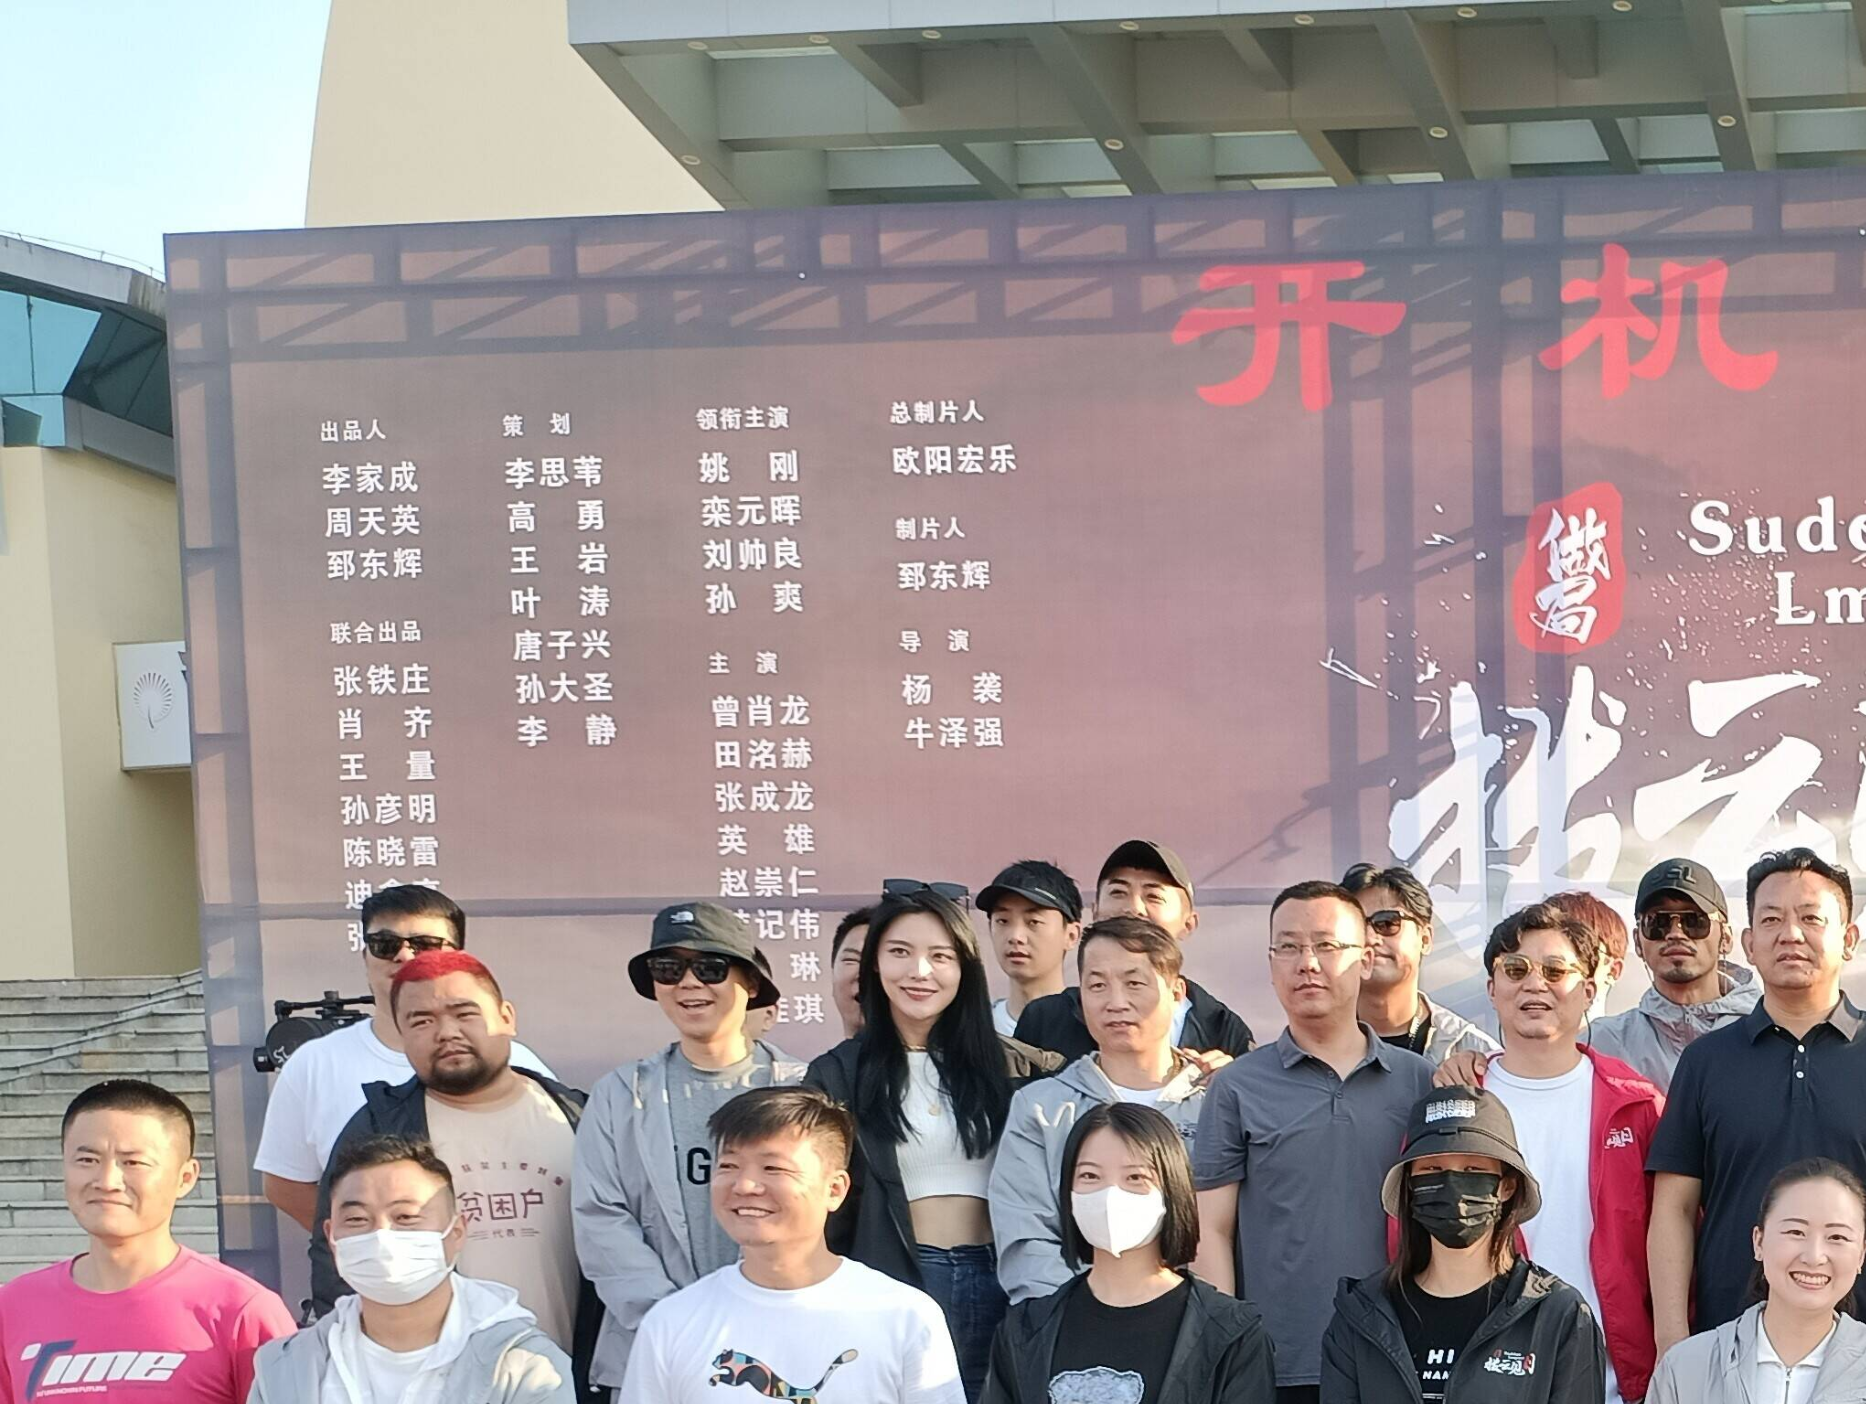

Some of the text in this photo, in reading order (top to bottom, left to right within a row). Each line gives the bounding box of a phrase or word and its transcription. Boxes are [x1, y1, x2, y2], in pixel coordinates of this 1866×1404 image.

[696, 405, 790, 431] 领衔主演
[889, 400, 984, 424] 总制片人
[320, 419, 386, 442] 出品人
[505, 456, 603, 489] 李思苇
[892, 444, 1017, 475] 欧阳宏乐
[322, 461, 418, 495] 李家成
[325, 504, 420, 537] 周天英
[701, 495, 802, 528] 栾元晖
[895, 516, 966, 540] 制片人
[327, 548, 422, 580] 郅东辉
[702, 537, 802, 570] 刘帅良
[897, 560, 991, 591] 郅东辉
[330, 620, 422, 644] 联合出品
[513, 630, 611, 662] 唐子兴
[333, 663, 430, 696] 张铁庄
[516, 673, 613, 704] 孙大圣
[711, 694, 811, 728] 曾肖龙
[904, 716, 1004, 749] 牛泽强
[341, 793, 437, 825] 孙彦明
[715, 781, 814, 813] 张成龙
[343, 836, 439, 868] 陈晓雷
[719, 866, 819, 898] 赵崇仁
[731, 908, 820, 940] 记伟
[457, 1188, 543, 1222] 贫困户
